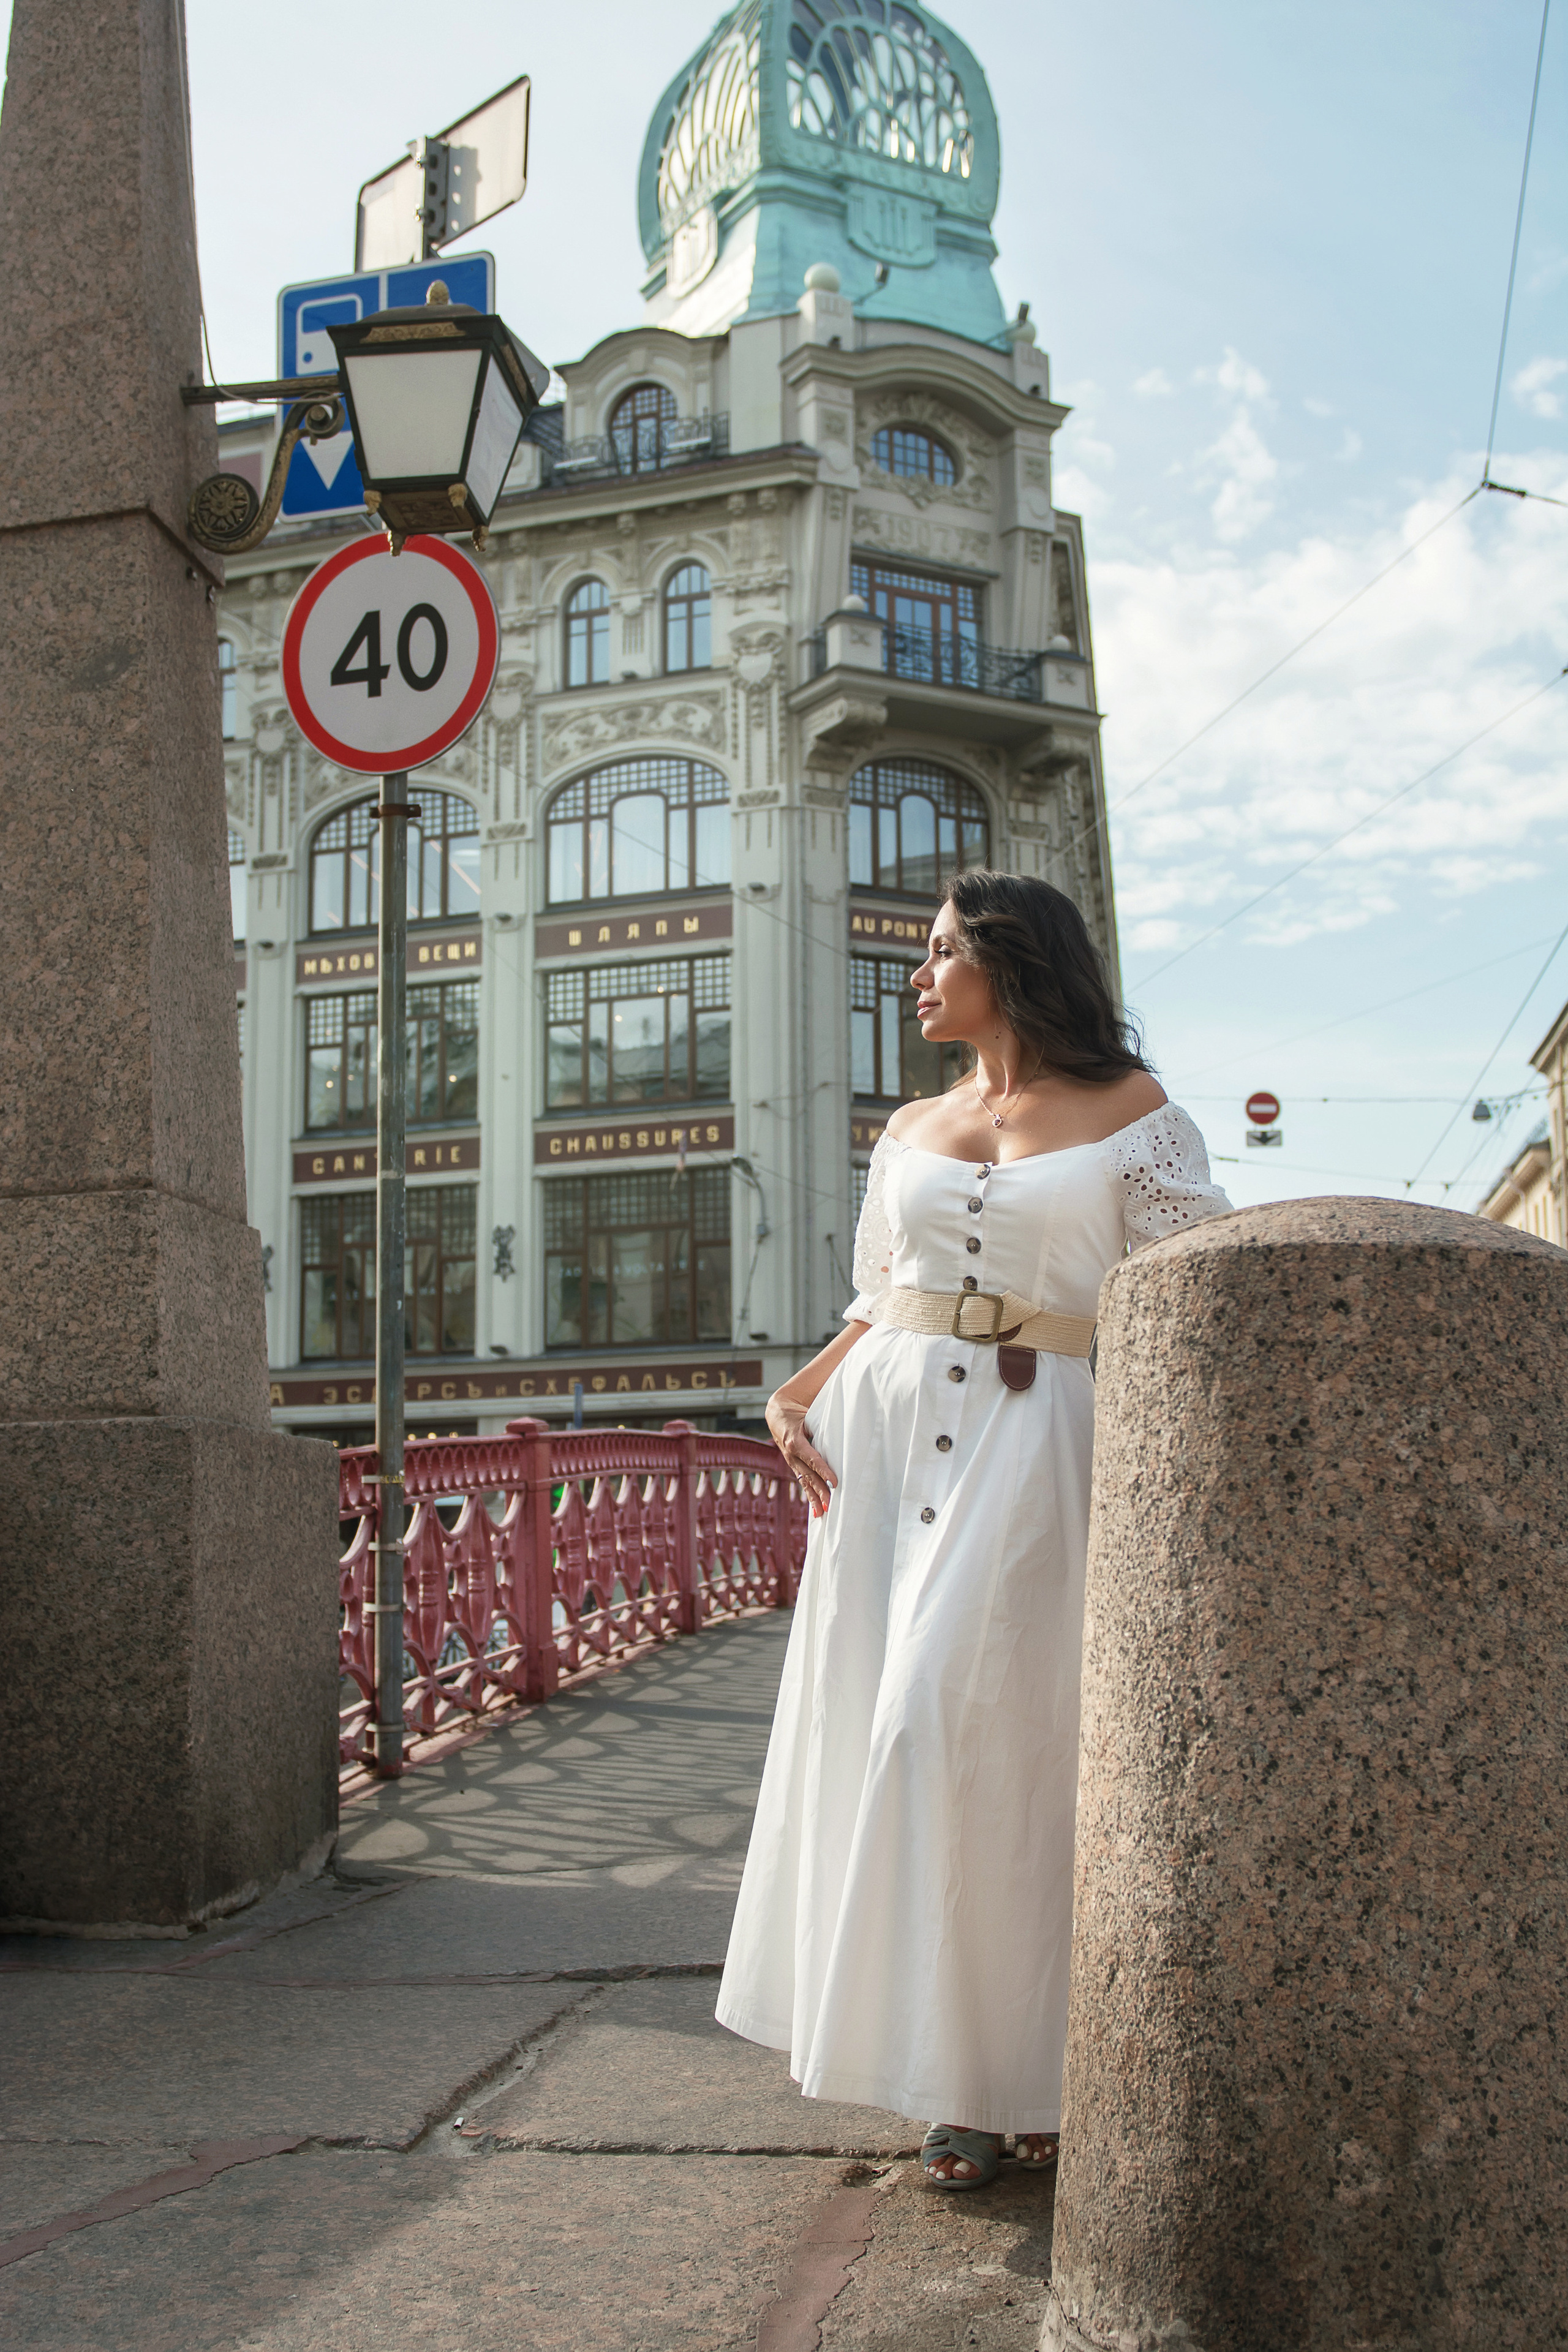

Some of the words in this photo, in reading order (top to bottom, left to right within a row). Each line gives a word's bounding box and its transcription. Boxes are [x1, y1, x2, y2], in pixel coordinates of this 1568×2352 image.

[330, 602, 448, 698] 40
[568, 916, 699, 946] ШЛЯПЫ
[851, 915, 876, 933] AU
[881, 918, 929, 940] PONT
[418, 941, 477, 963] ВЕЩИ
[549, 1125, 720, 1155] CHAUSSURES
[312, 1145, 461, 1175] GANRIE
